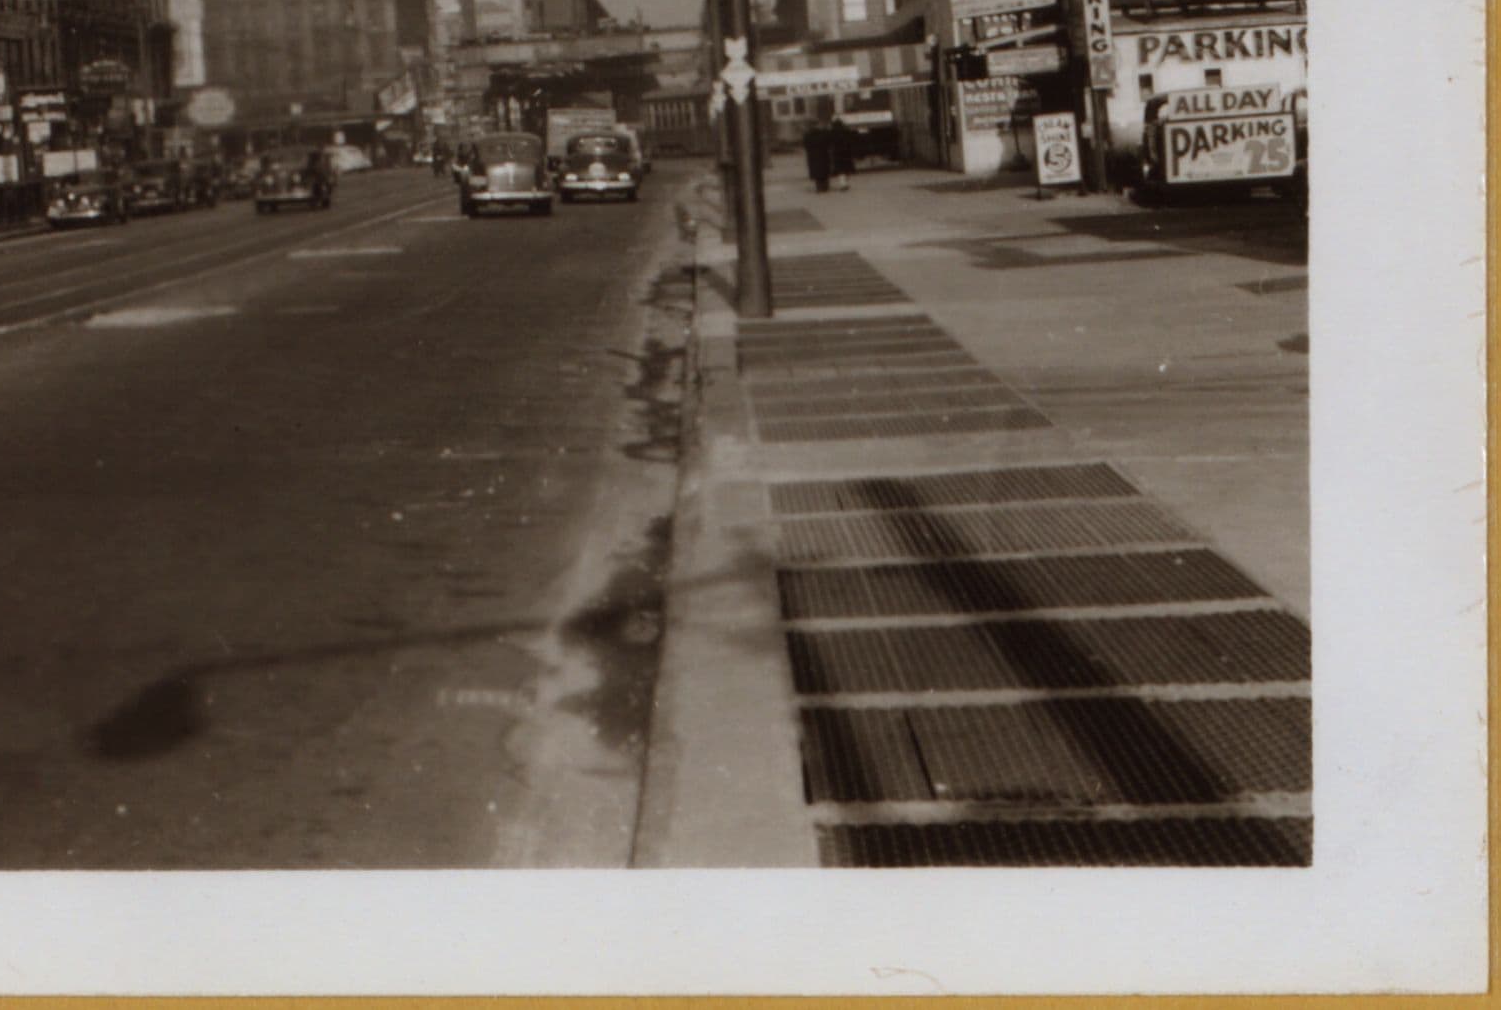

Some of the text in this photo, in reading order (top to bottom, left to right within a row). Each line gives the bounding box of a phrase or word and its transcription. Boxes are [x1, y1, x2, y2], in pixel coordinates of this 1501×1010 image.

[1175, 88, 1274, 115] ALL DAY
[1170, 118, 1287, 178] PARKING
[1243, 137, 1292, 175] 25
